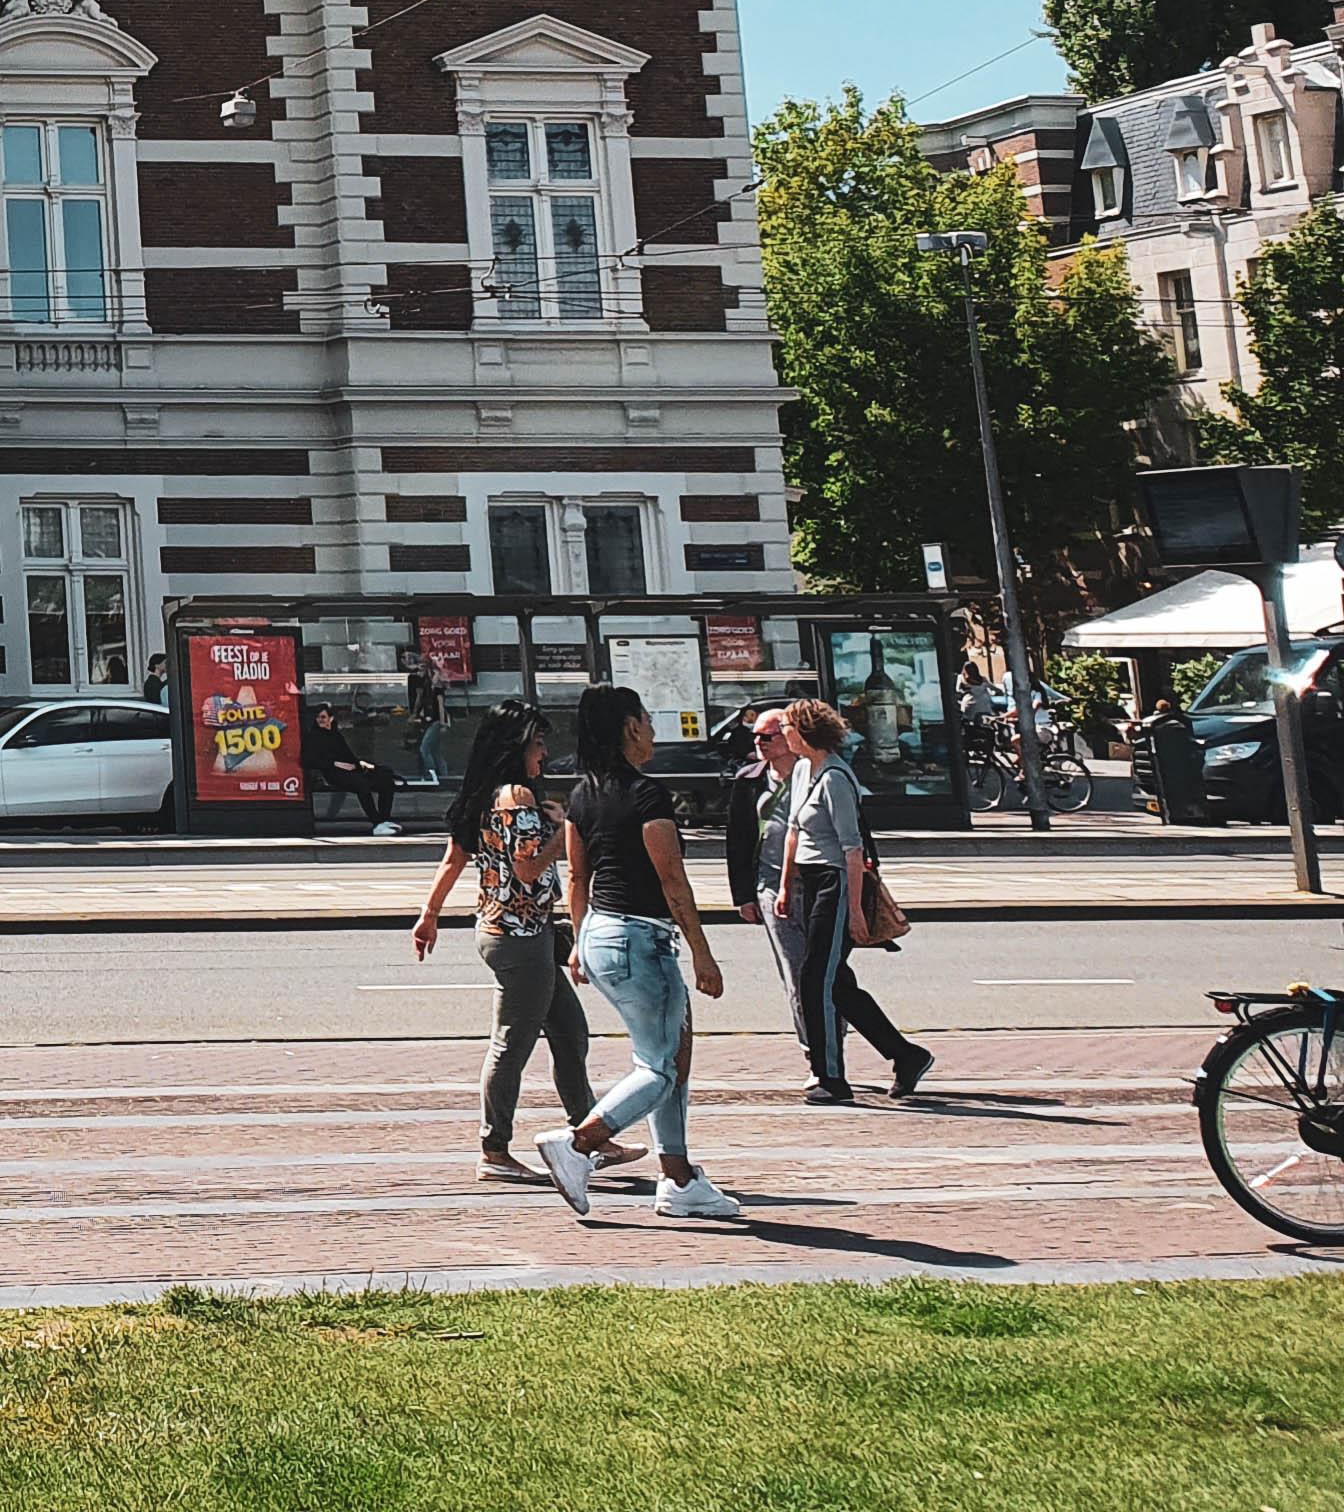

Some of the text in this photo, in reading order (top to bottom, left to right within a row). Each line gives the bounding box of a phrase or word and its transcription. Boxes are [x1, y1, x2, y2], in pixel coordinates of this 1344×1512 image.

[213, 645, 249, 663] FEEST
[234, 663, 270, 680] RADIO
[217, 705, 267, 723] FOUTE
[214, 724, 281, 757] 1500
